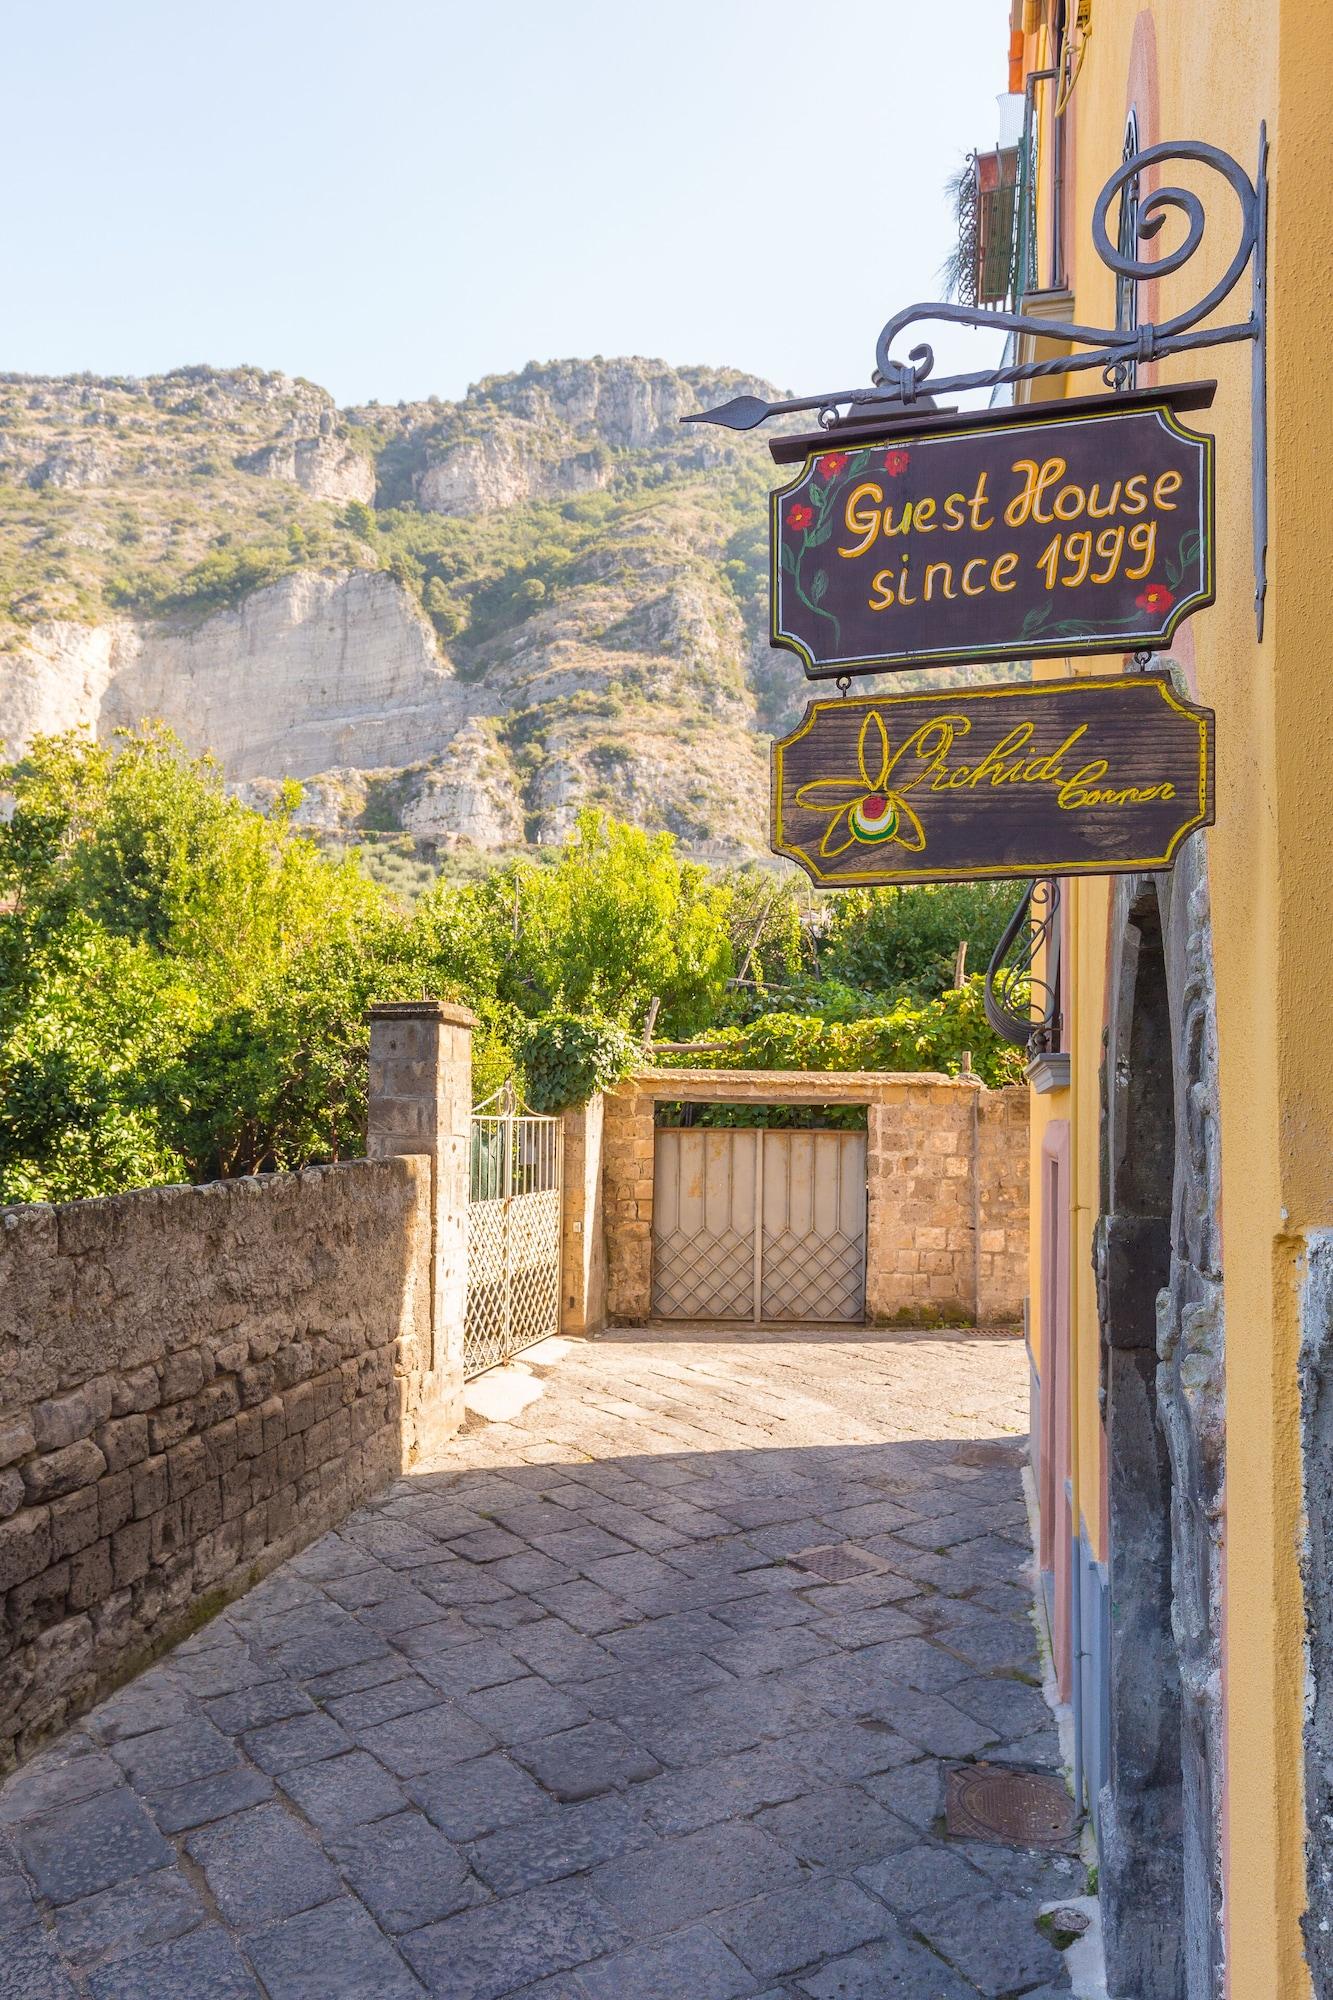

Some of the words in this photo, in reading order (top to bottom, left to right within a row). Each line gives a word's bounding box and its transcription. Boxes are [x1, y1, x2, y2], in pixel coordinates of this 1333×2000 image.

[838, 472, 995, 558] Guest
[1004, 457, 1182, 527] House
[868, 552, 1019, 611] since
[1036, 520, 1157, 590] 1999
[883, 714, 1088, 794] Orchid
[1053, 760, 1176, 809] Corner
